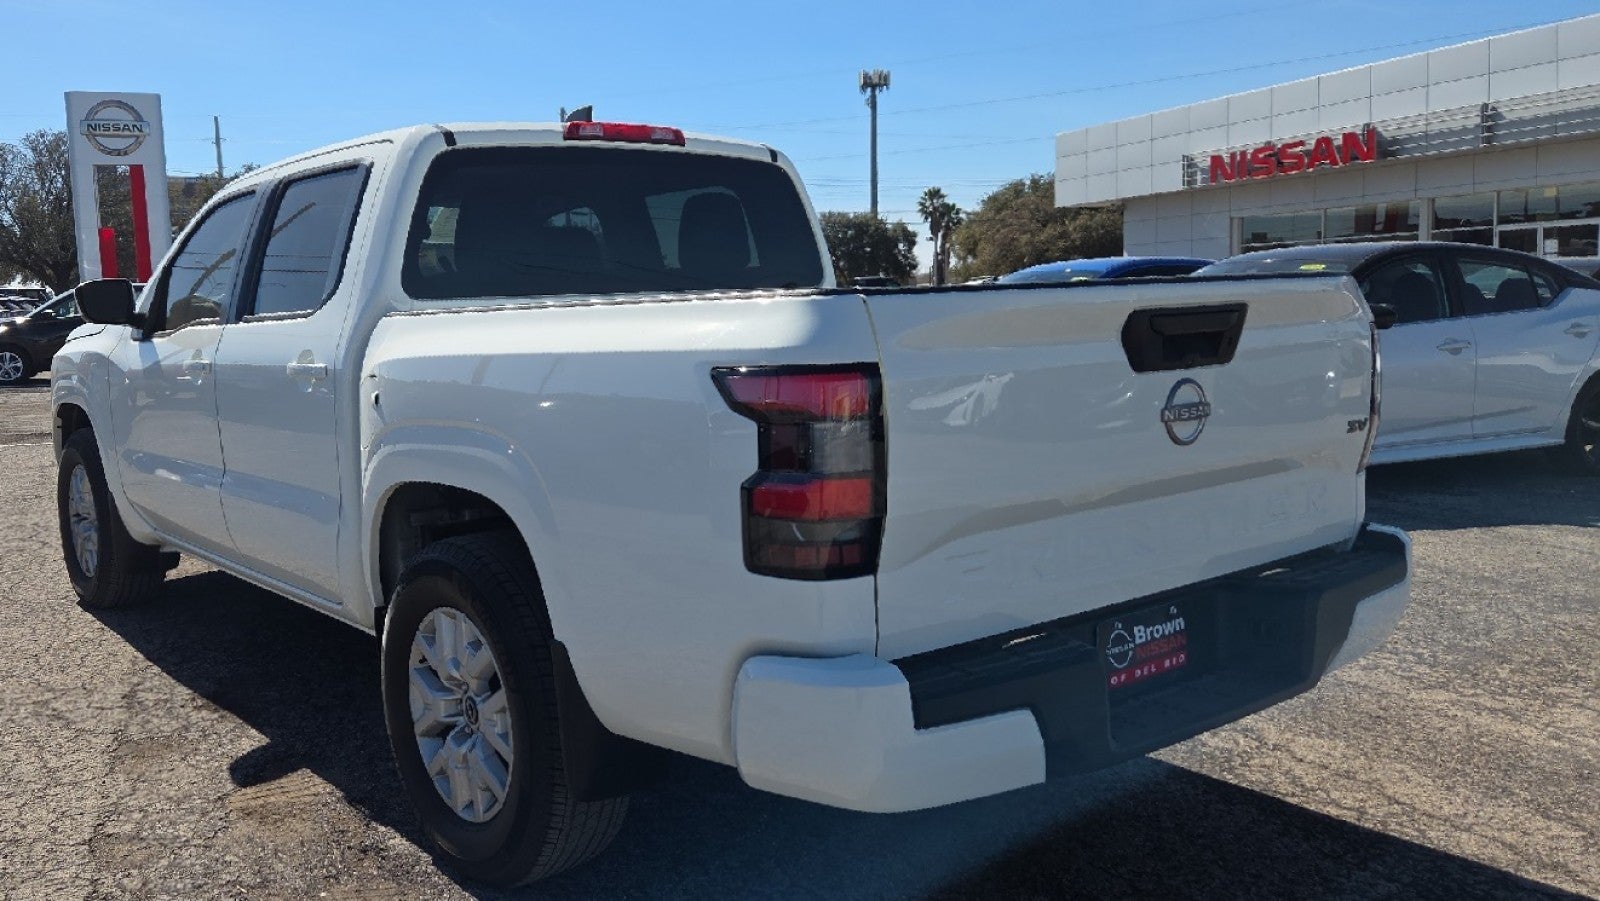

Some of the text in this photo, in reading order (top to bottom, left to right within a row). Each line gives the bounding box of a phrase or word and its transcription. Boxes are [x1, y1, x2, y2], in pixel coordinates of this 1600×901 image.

[86, 122, 144, 133] NISSAN
[1209, 125, 1377, 184] NISSAN
[1164, 403, 1209, 420] NISSAN
[1347, 417, 1368, 433] SV
[1134, 617, 1185, 645] Brown
[1136, 632, 1187, 657] NISSAN
[1110, 653, 1186, 685] OF DEL RIO
